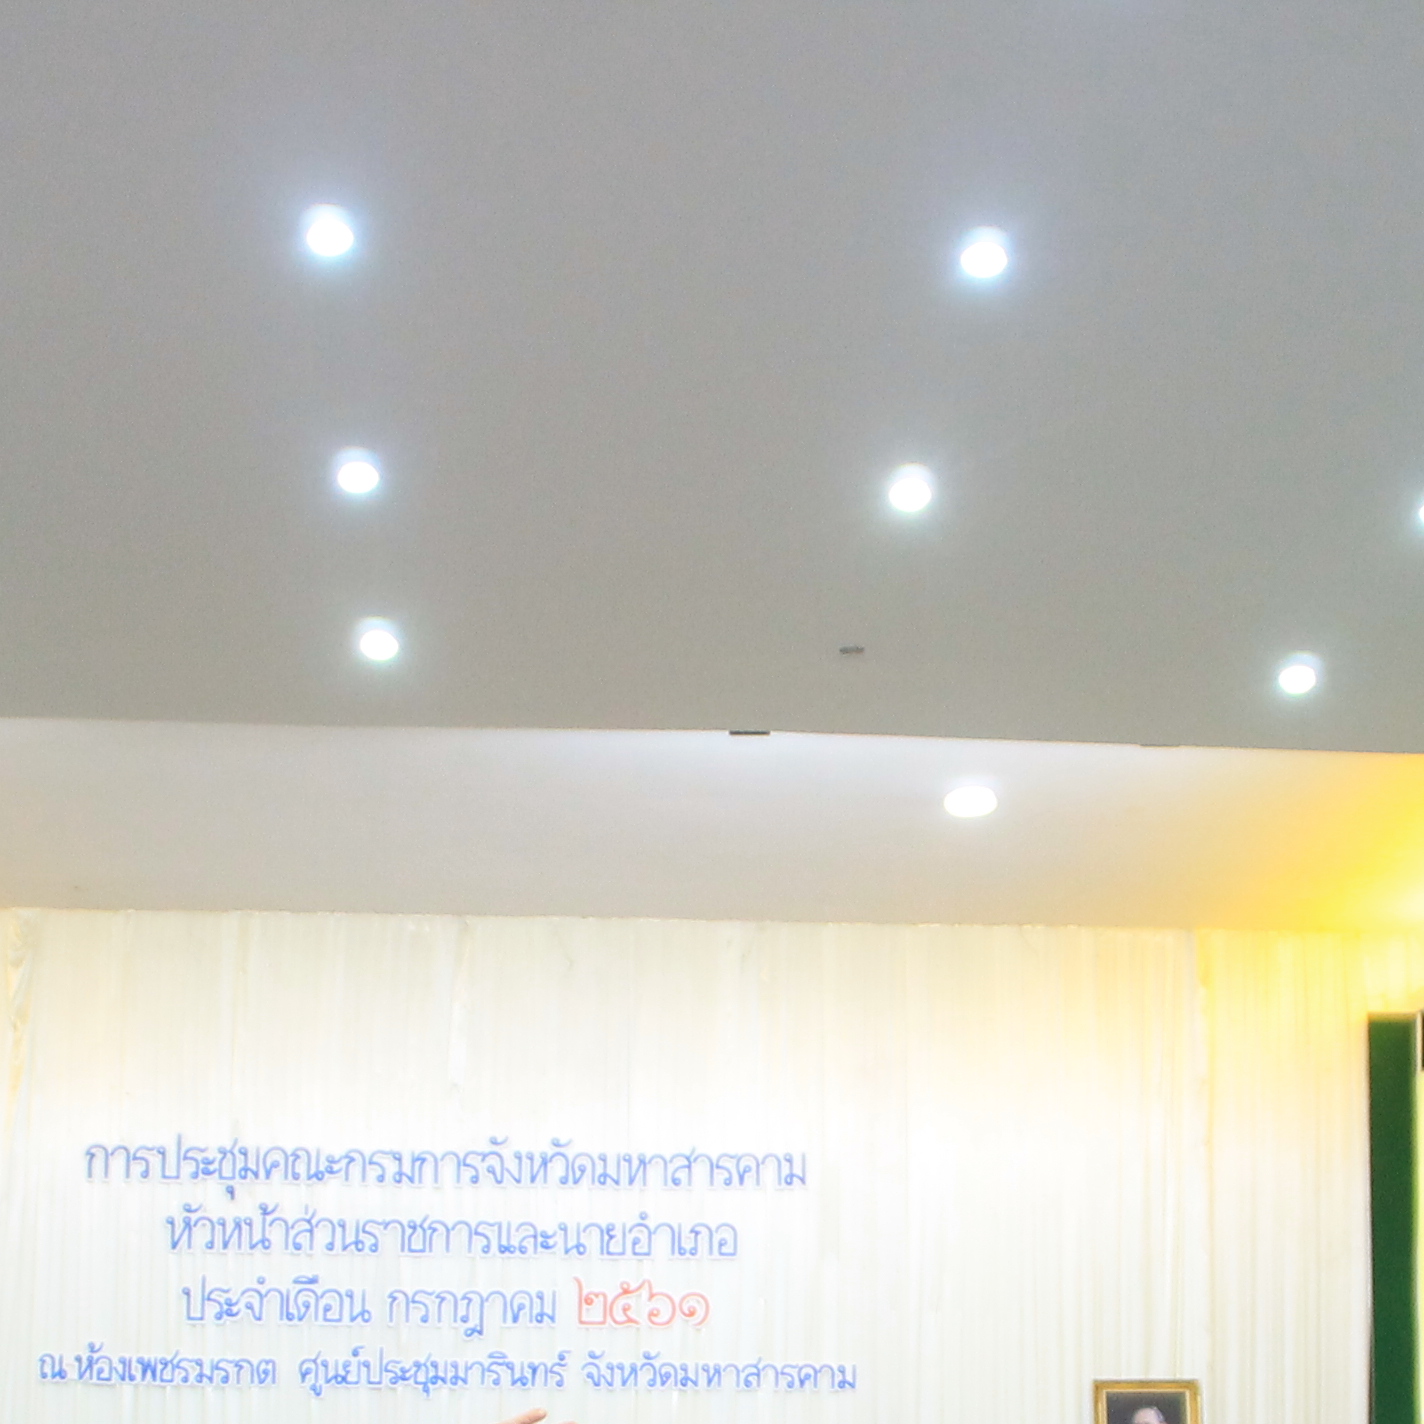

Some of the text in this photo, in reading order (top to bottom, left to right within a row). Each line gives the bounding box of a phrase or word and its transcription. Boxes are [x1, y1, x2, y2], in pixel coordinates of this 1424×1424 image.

[84, 1136, 806, 1198] การประชุมคณะกรมการจังหวัดมหาสารคาม
[164, 1204, 738, 1257] หัวหน้าส่วนราชการและนายอำเภอ
[181, 1275, 712, 1339] ประจำเดือน กรกฎาคม ๒๕๖๑
[73, 1342, 277, 1386] ห้องเพชรมรกต
[298, 1345, 572, 1398] ศูนย์ประชุมมารินทร์
[581, 1350, 858, 1391] จังหวัดมหาสารคาม
